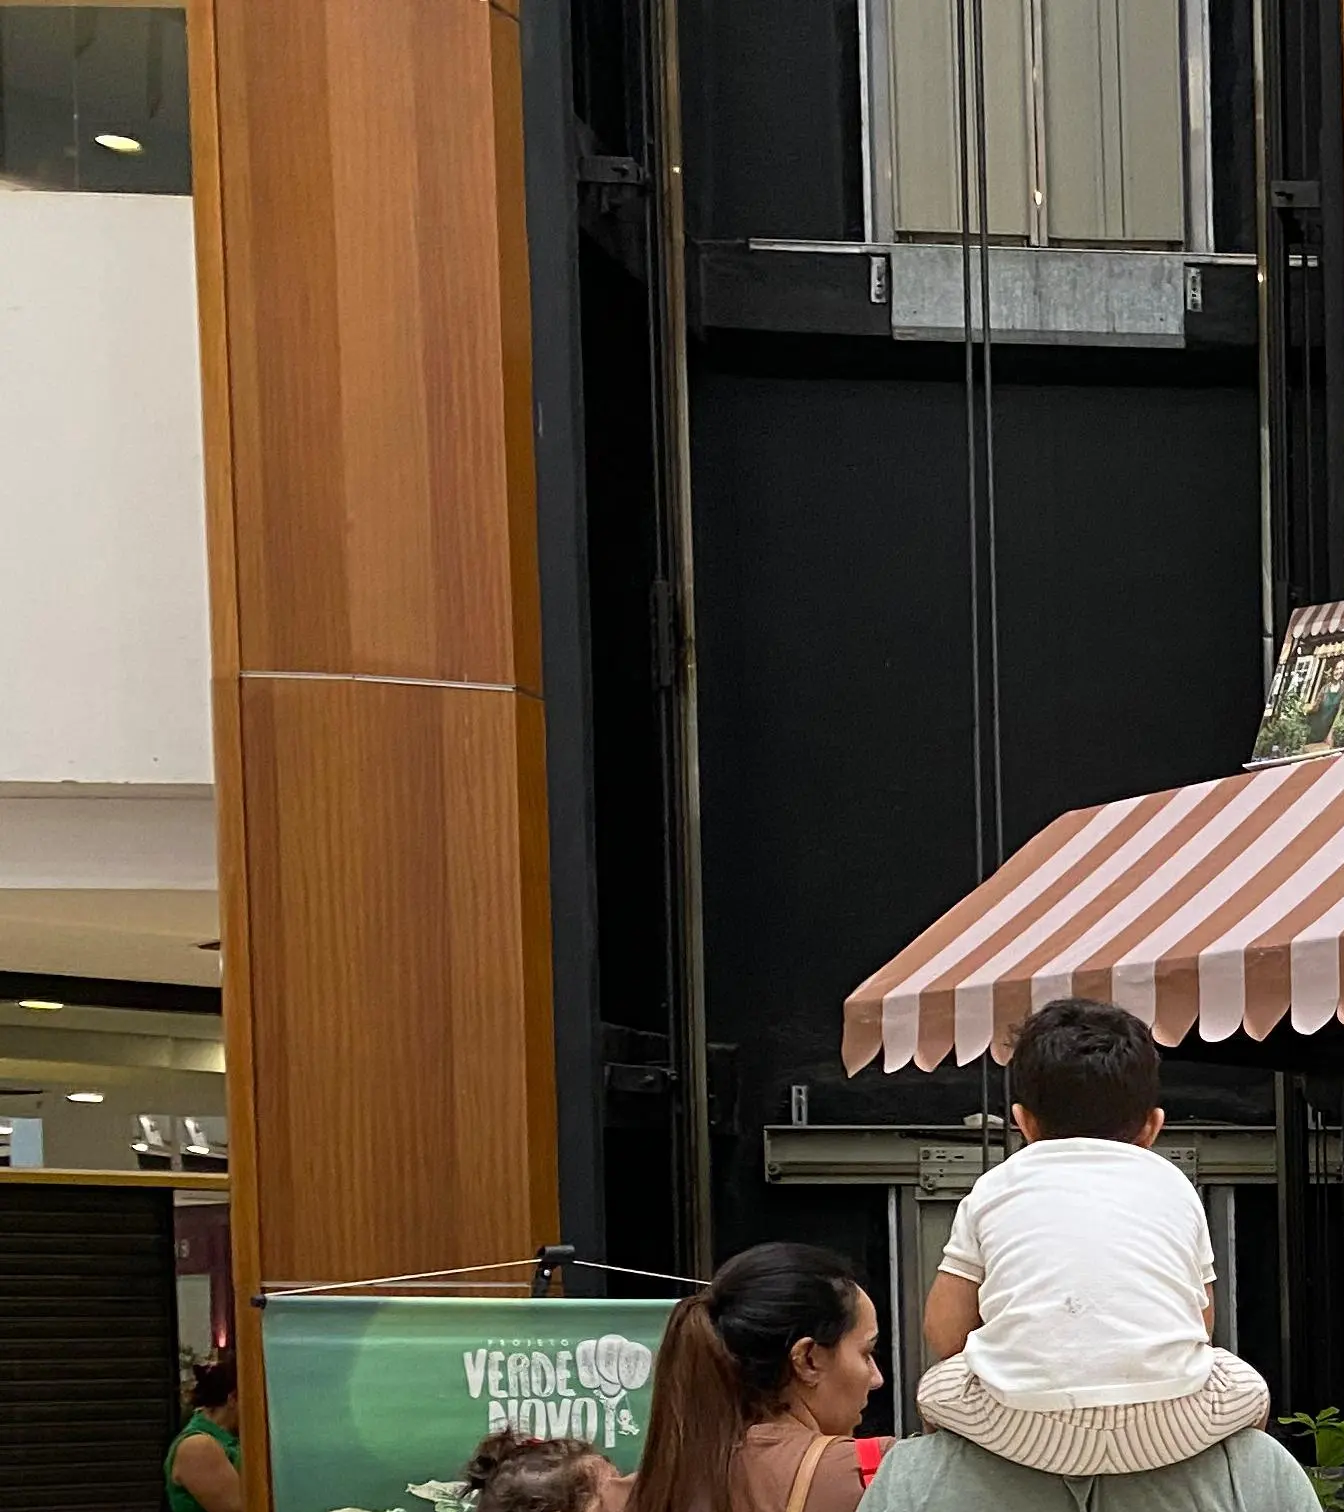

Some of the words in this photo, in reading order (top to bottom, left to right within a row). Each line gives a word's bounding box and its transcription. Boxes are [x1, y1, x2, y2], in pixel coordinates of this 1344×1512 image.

[487, 1338, 570, 1347] PROJETO
[463, 1349, 577, 1399] VERDE
[488, 1398, 598, 1444] NOVO
